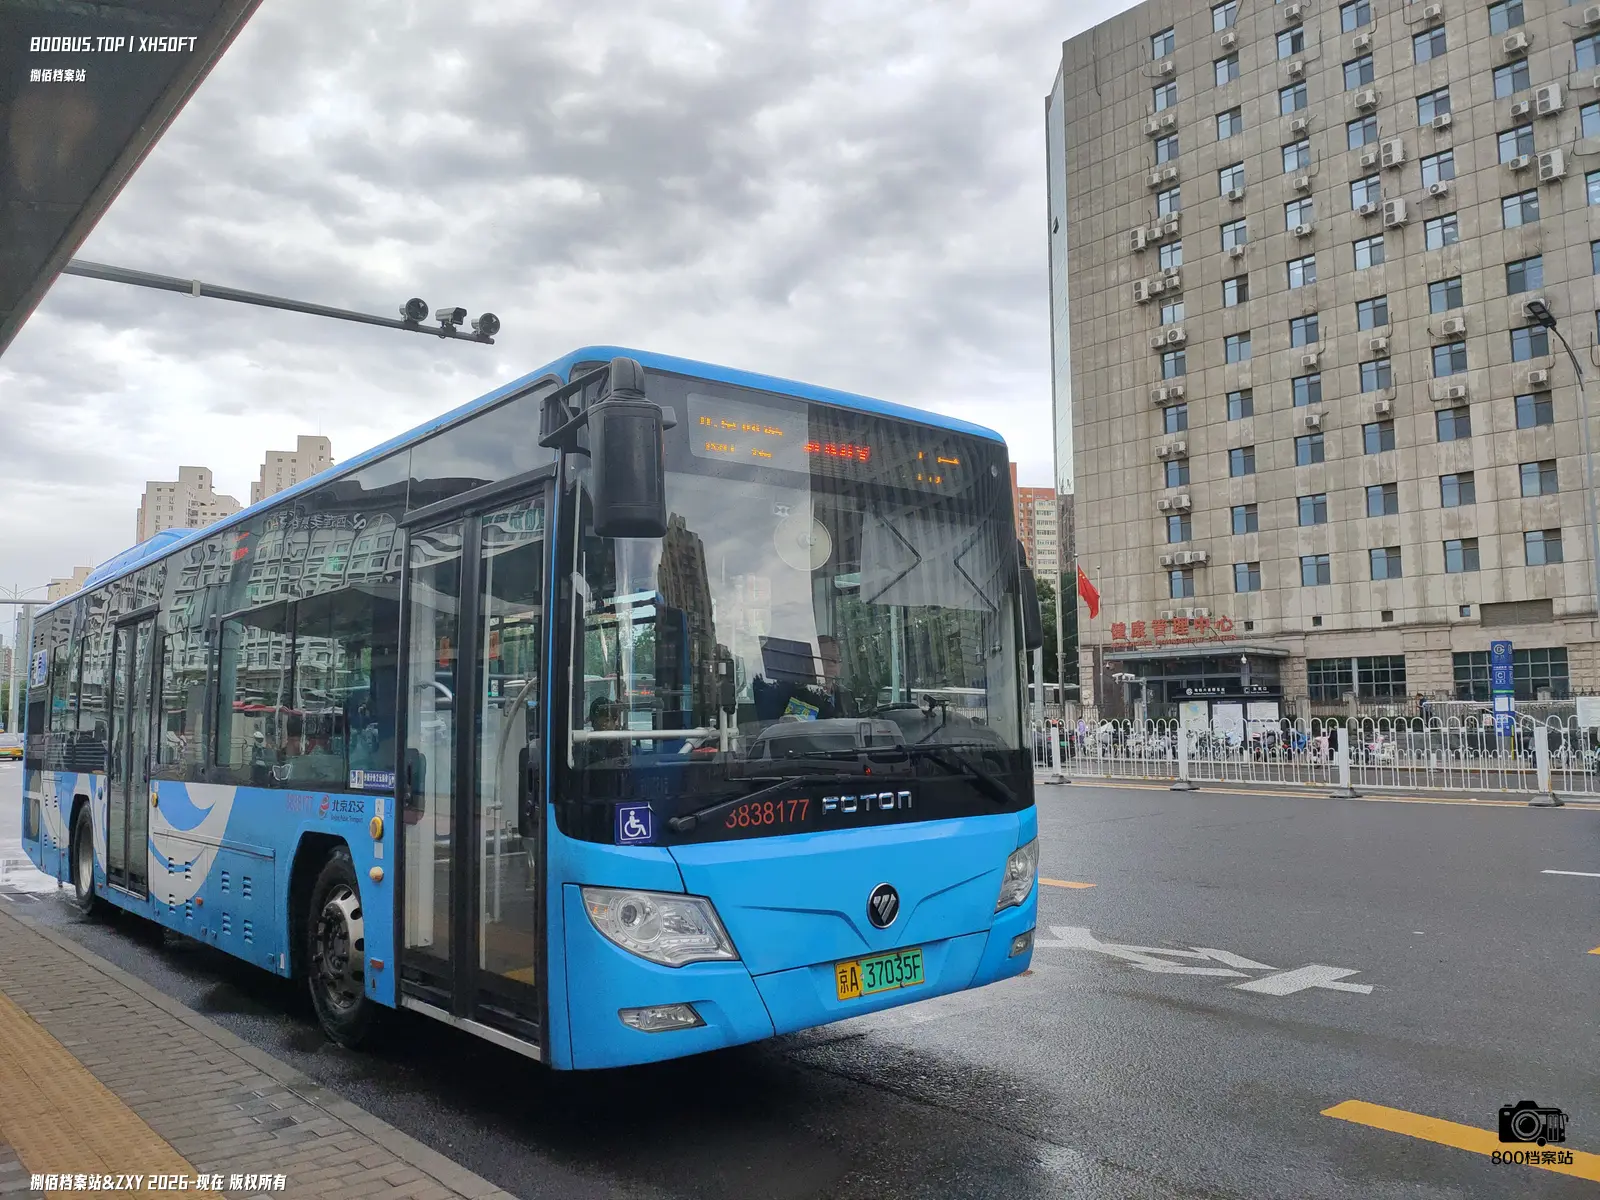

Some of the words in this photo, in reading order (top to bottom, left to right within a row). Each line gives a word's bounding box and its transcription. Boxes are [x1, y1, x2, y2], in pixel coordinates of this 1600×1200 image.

[1111, 615, 1233, 639] 健康管理中心
[331, 799, 365, 813] 北京公交
[725, 799, 810, 829] 3838177
[821, 791, 912, 815] FOTON
